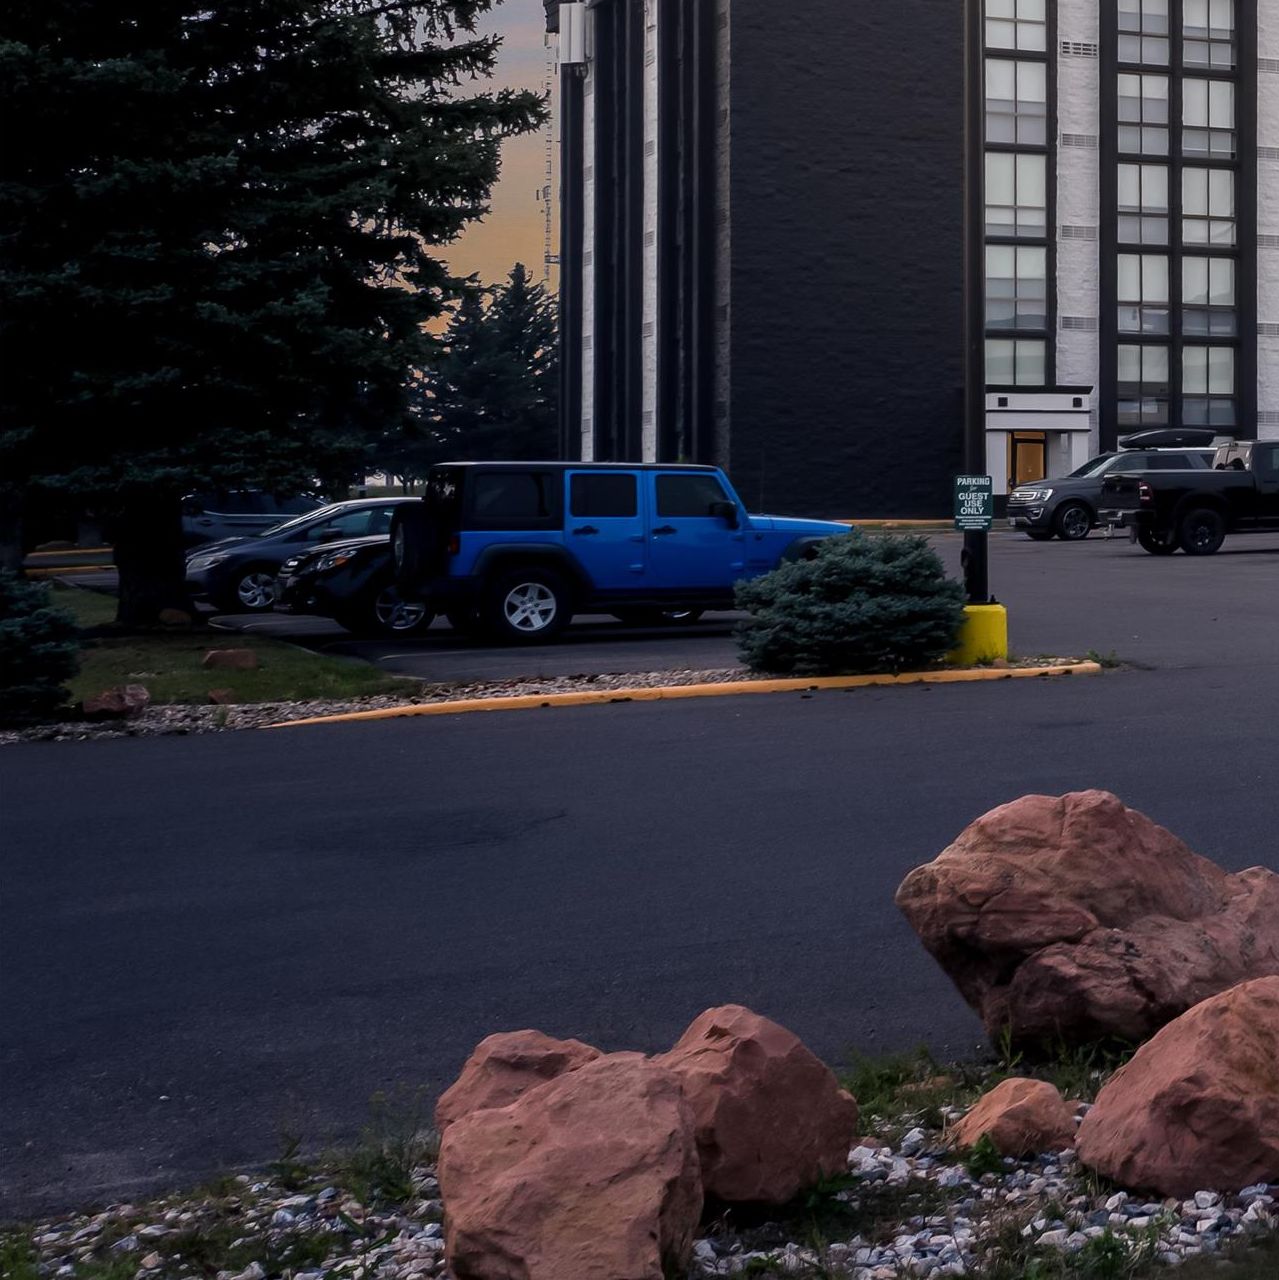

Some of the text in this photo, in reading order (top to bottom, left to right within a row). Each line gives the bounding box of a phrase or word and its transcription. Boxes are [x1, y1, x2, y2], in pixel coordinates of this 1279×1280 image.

[957, 477, 990, 486] PARKING
[958, 492, 989, 500] GUEST
[960, 507, 984, 515] ONLY
